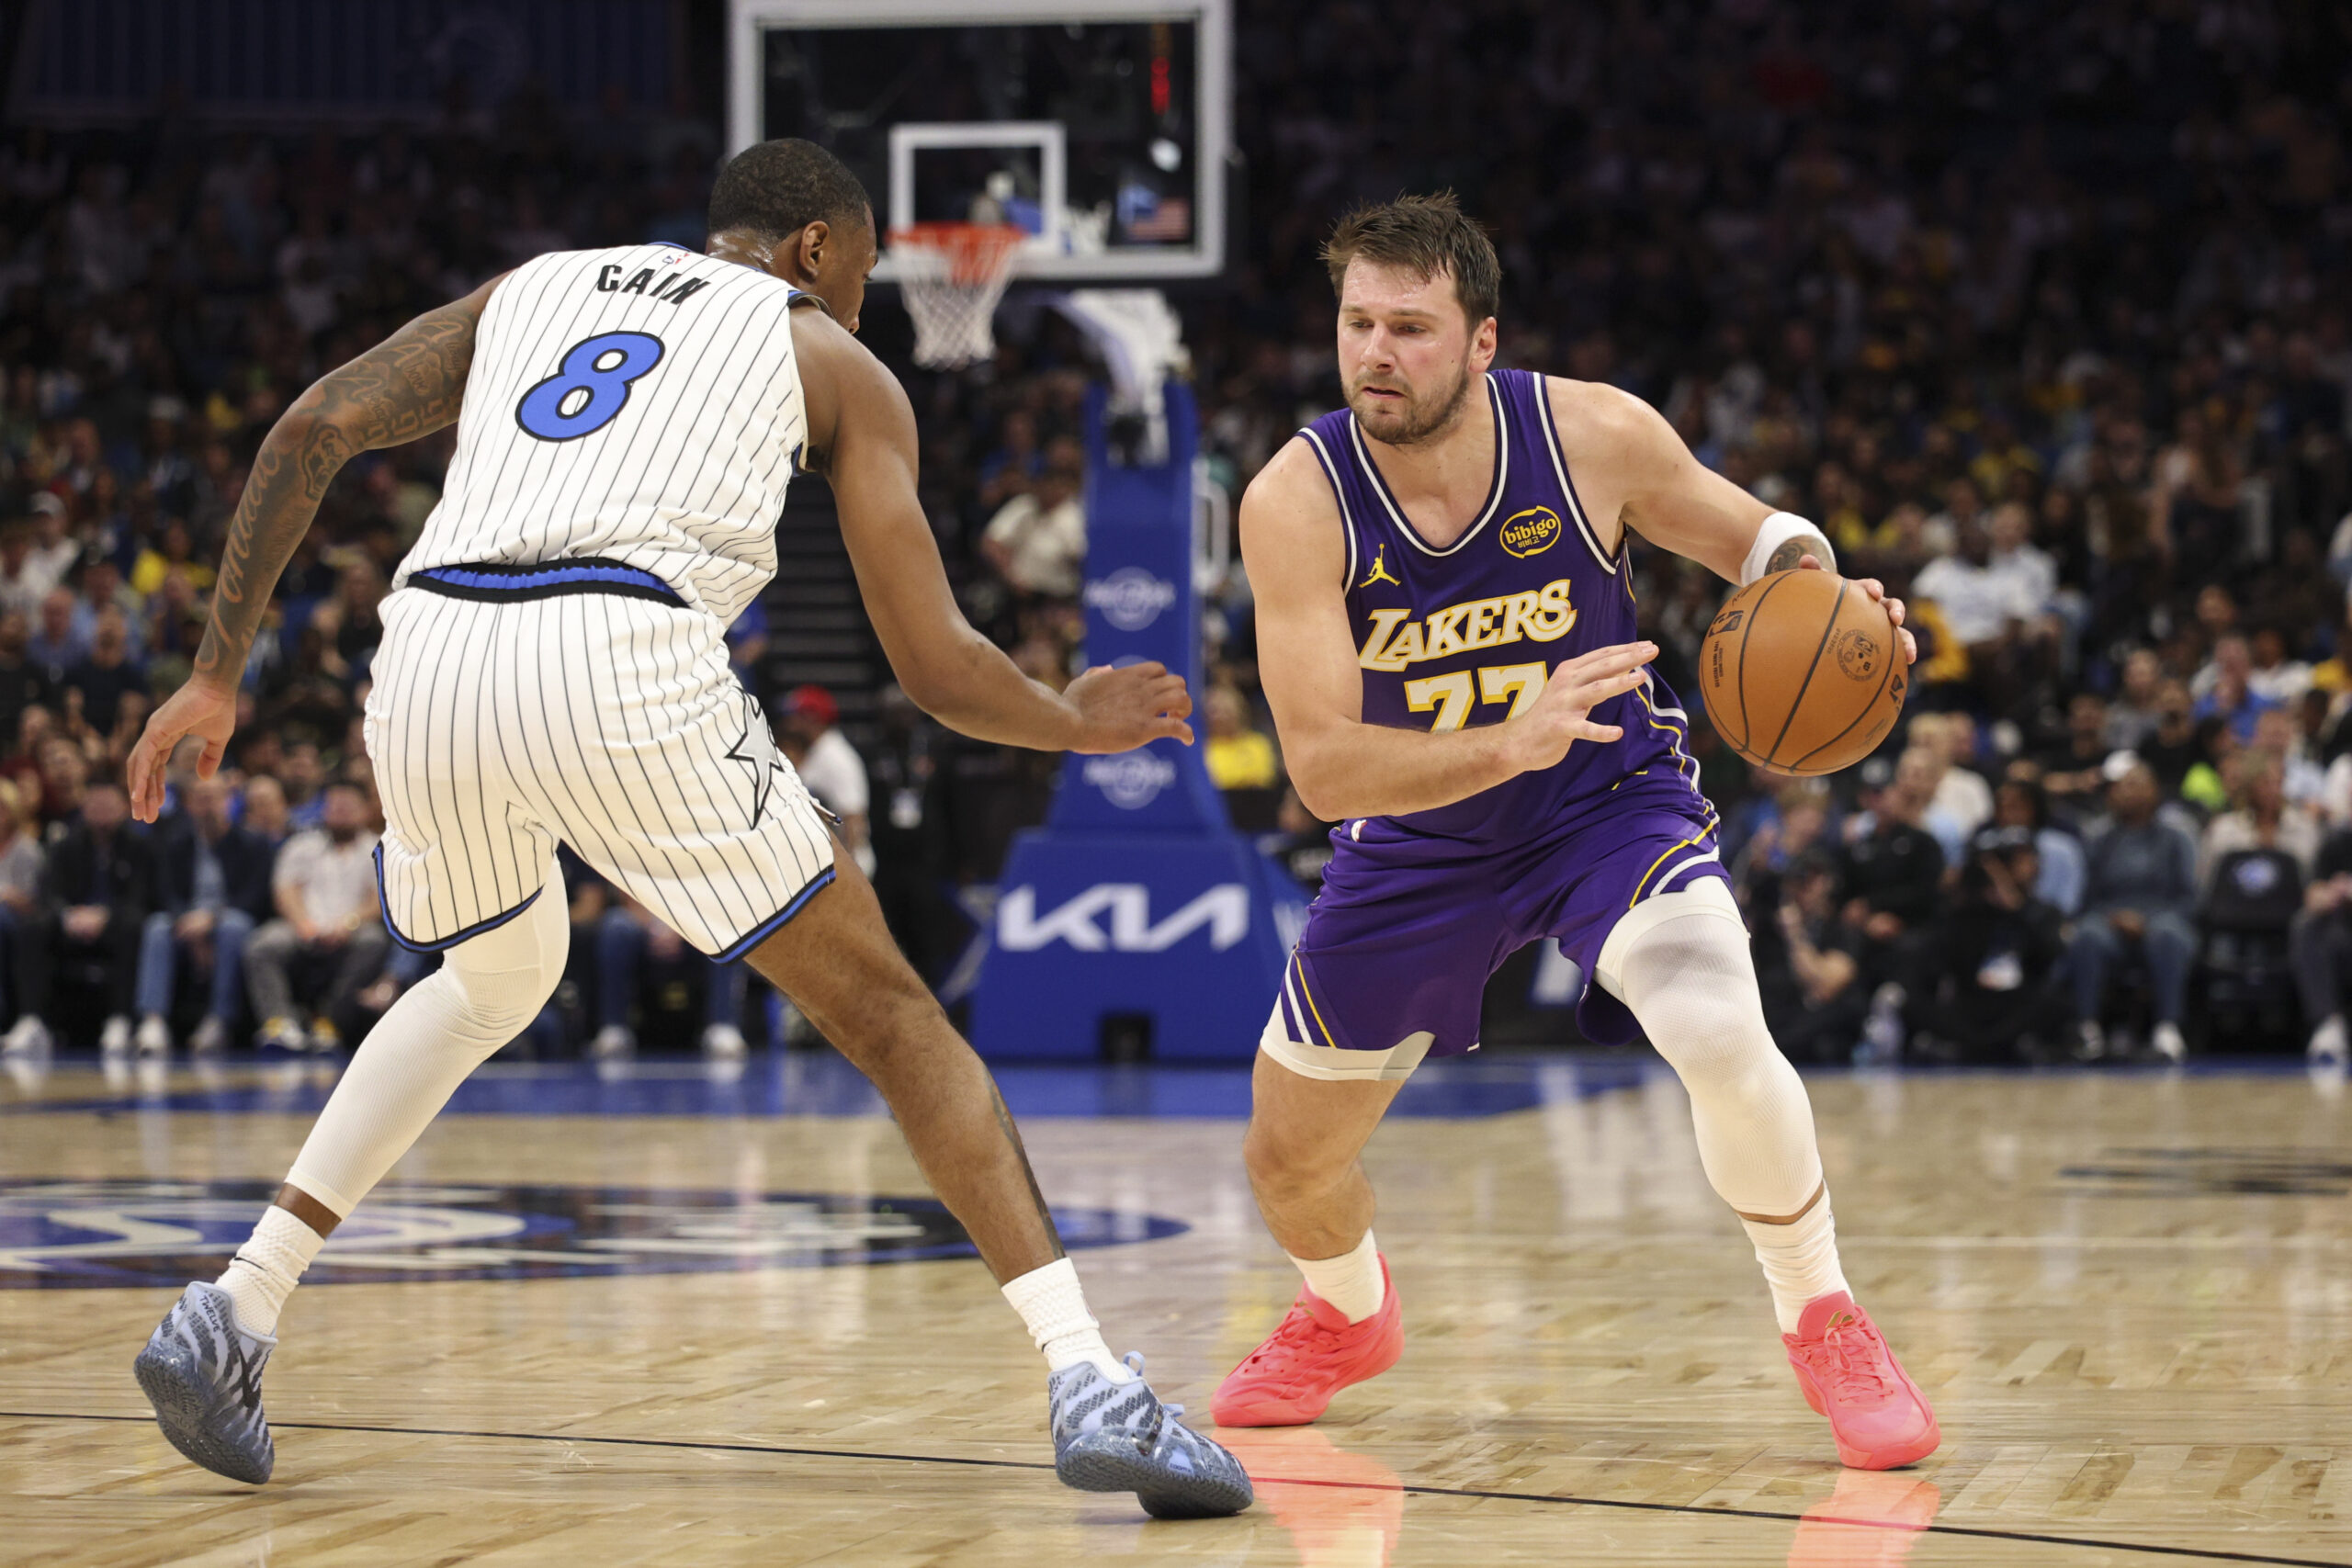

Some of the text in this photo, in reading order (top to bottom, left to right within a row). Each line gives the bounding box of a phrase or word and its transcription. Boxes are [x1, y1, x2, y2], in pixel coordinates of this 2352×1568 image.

[597, 265, 711, 305] CAIN
[514, 331, 666, 443] 8
[1504, 518, 1556, 544] bibigo
[1358, 579, 1577, 671] LAKERS
[1404, 660, 1549, 734] 77
[996, 883, 1250, 952] KIA
[199, 1295, 221, 1332] TWELVE
